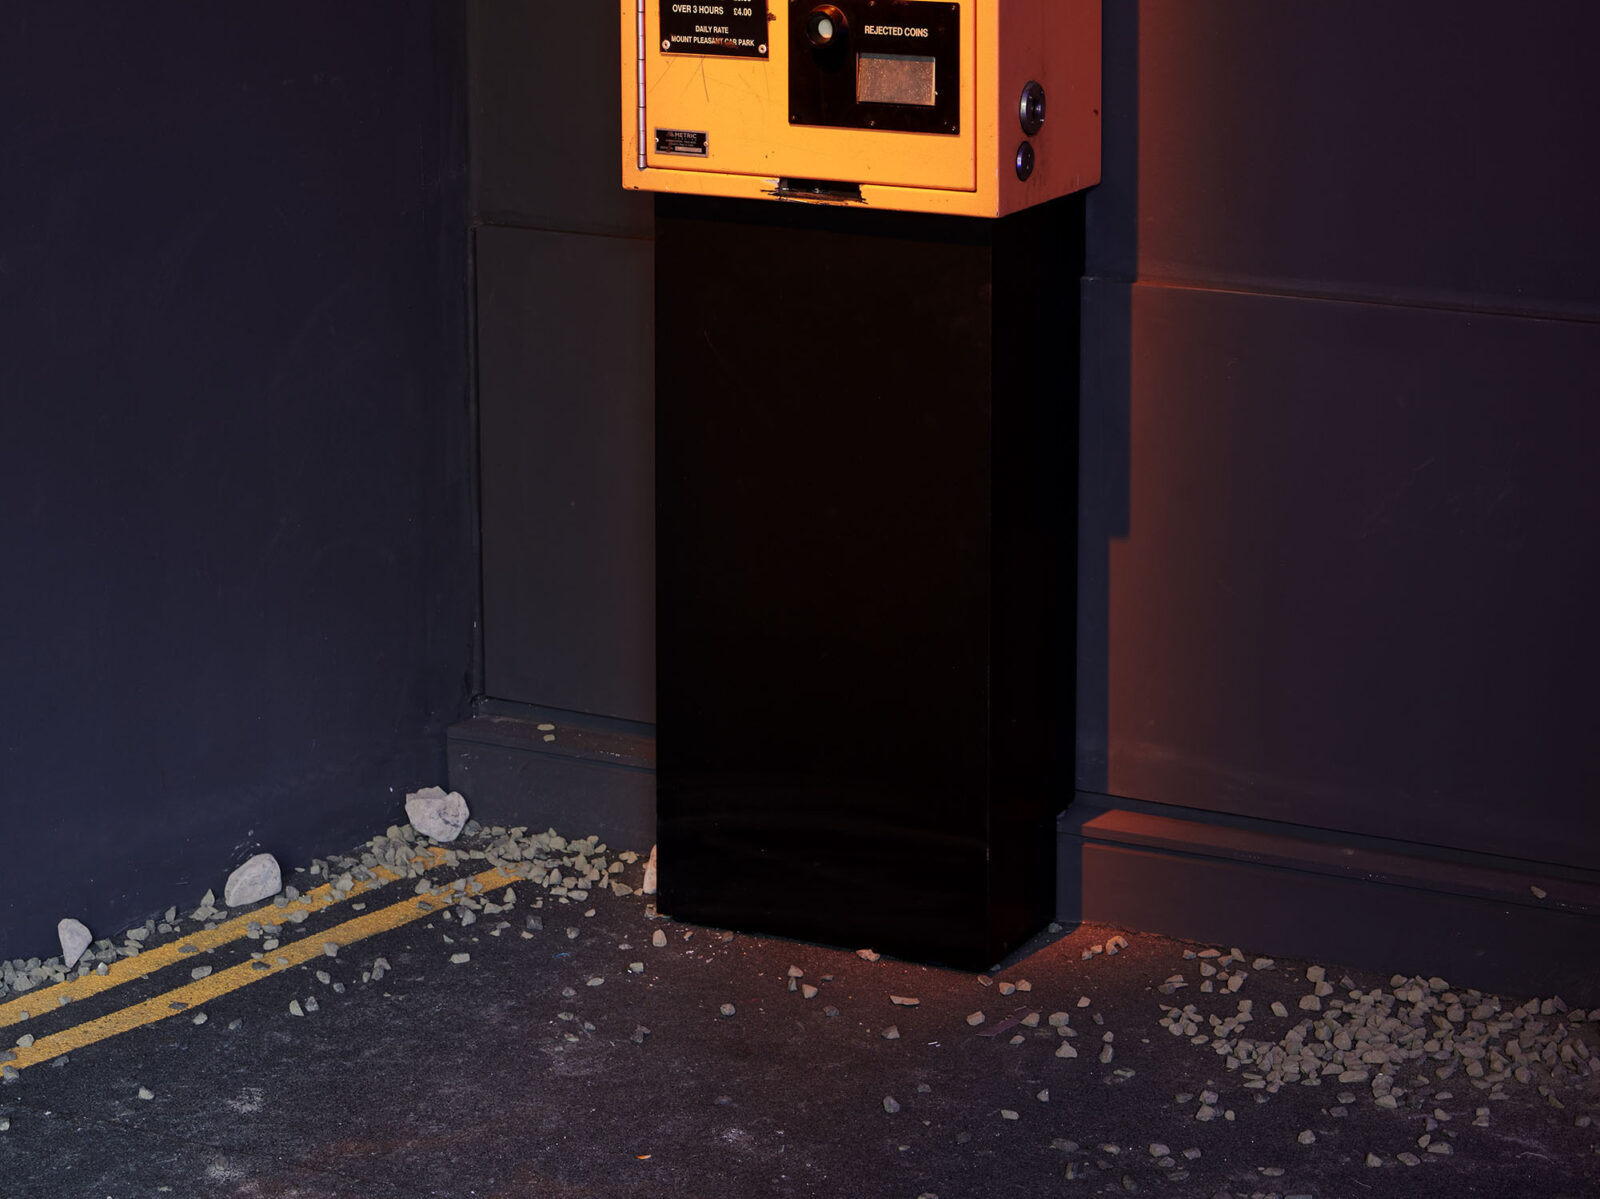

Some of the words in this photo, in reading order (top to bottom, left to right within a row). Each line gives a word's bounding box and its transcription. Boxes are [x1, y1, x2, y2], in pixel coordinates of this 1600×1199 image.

[672, 5, 691, 13] OVER
[699, 6, 723, 14] HOURS
[733, 8, 752, 16] £4.00
[695, 25, 712, 33] DAILY
[865, 26, 903, 36] REJECTED
[904, 28, 928, 37] COINS
